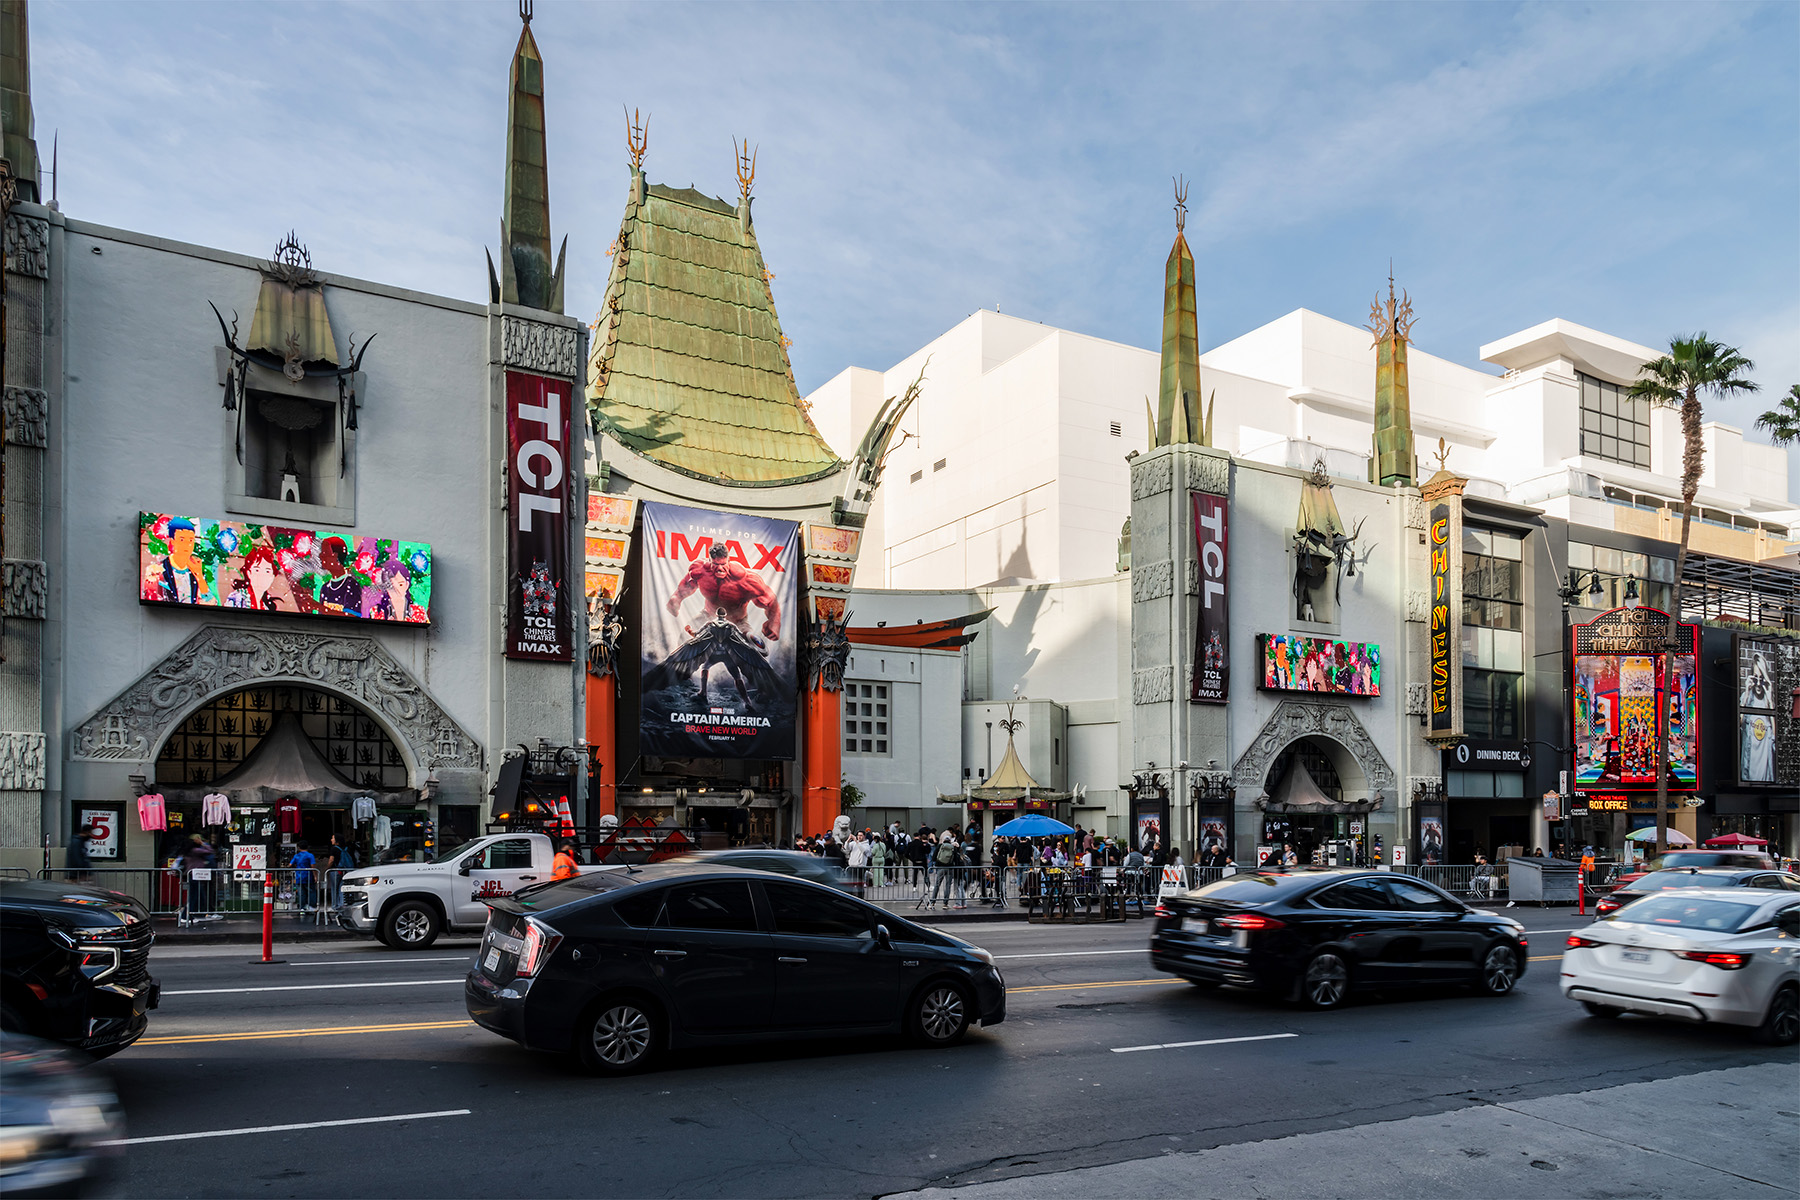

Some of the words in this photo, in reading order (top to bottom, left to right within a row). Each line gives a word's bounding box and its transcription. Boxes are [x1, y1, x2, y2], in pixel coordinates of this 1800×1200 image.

[517, 392, 563, 532] TCL
[689, 525, 731, 537] FILMED
[738, 531, 756, 539] FOR
[656, 530, 786, 573] IMAX
[1201, 507, 1224, 609] TCL
[524, 616, 556, 628] TCL
[1431, 518, 1448, 714] CHINESE
[1620, 610, 1652, 623] TCL
[523, 627, 556, 636] CHINESE
[524, 633, 556, 642] THEATRES
[518, 642, 561, 654] IMAX
[1204, 670, 1221, 679] TCL
[1198, 689, 1222, 698] IMAX
[670, 712, 719, 725] CAPTAIN
[721, 715, 771, 727] AMERICA
[685, 725, 711, 734] BRAVE
[712, 726, 730, 735] NEW
[730, 727, 757, 736] WORLD
[1476, 750, 1501, 760] DINING
[1502, 751, 1520, 760] DECK
[1589, 800, 1603, 810] BOX
[1604, 800, 1628, 810] OFFICE
[480, 880, 504, 890] JCL
